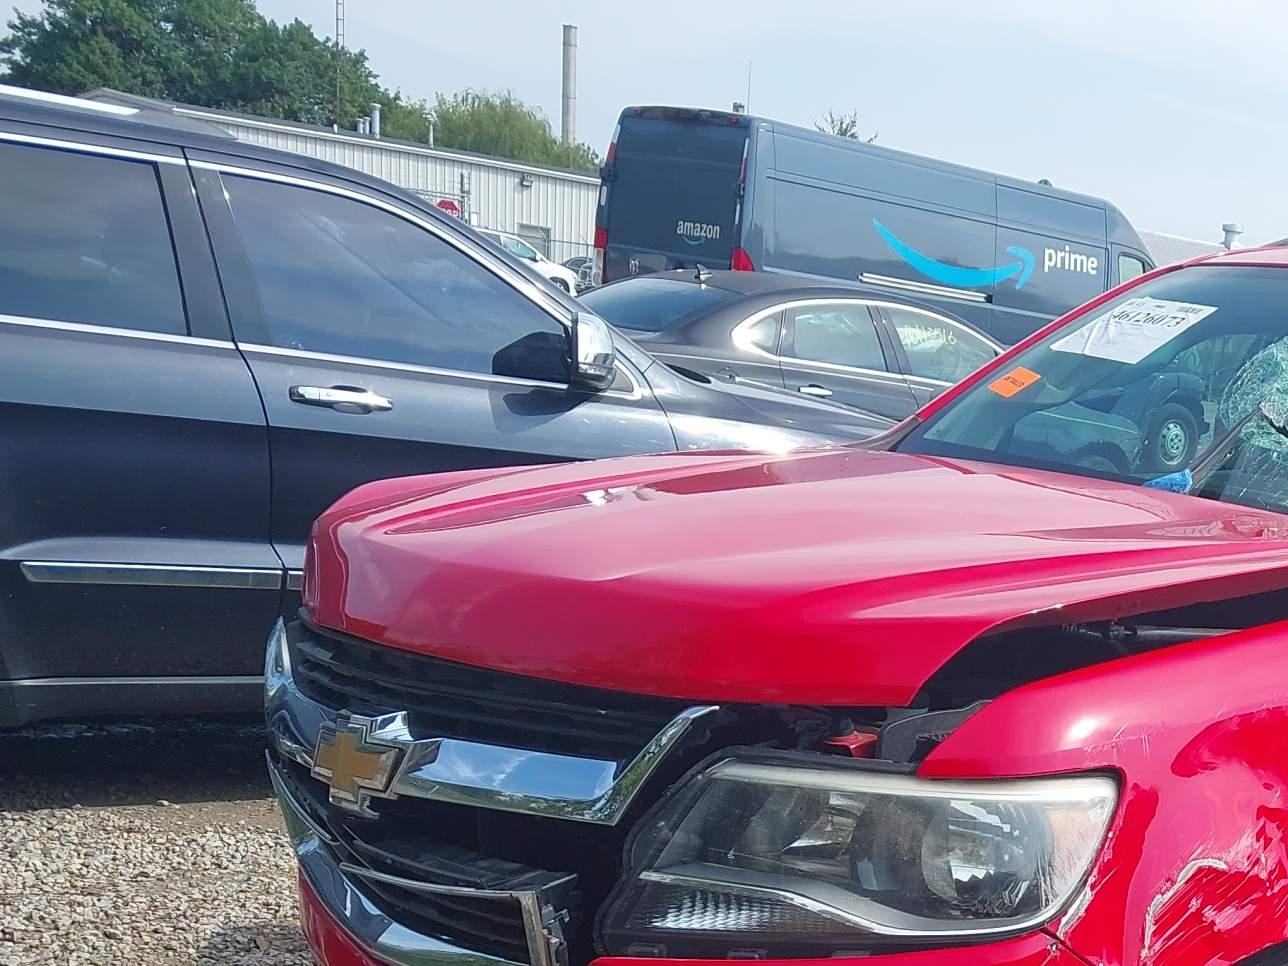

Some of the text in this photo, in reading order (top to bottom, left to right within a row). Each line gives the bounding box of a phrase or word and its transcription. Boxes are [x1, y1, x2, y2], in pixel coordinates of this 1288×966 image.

[677, 220, 720, 239] amazon
[1044, 245, 1098, 275] prime
[1112, 310, 1186, 327] 46126073
